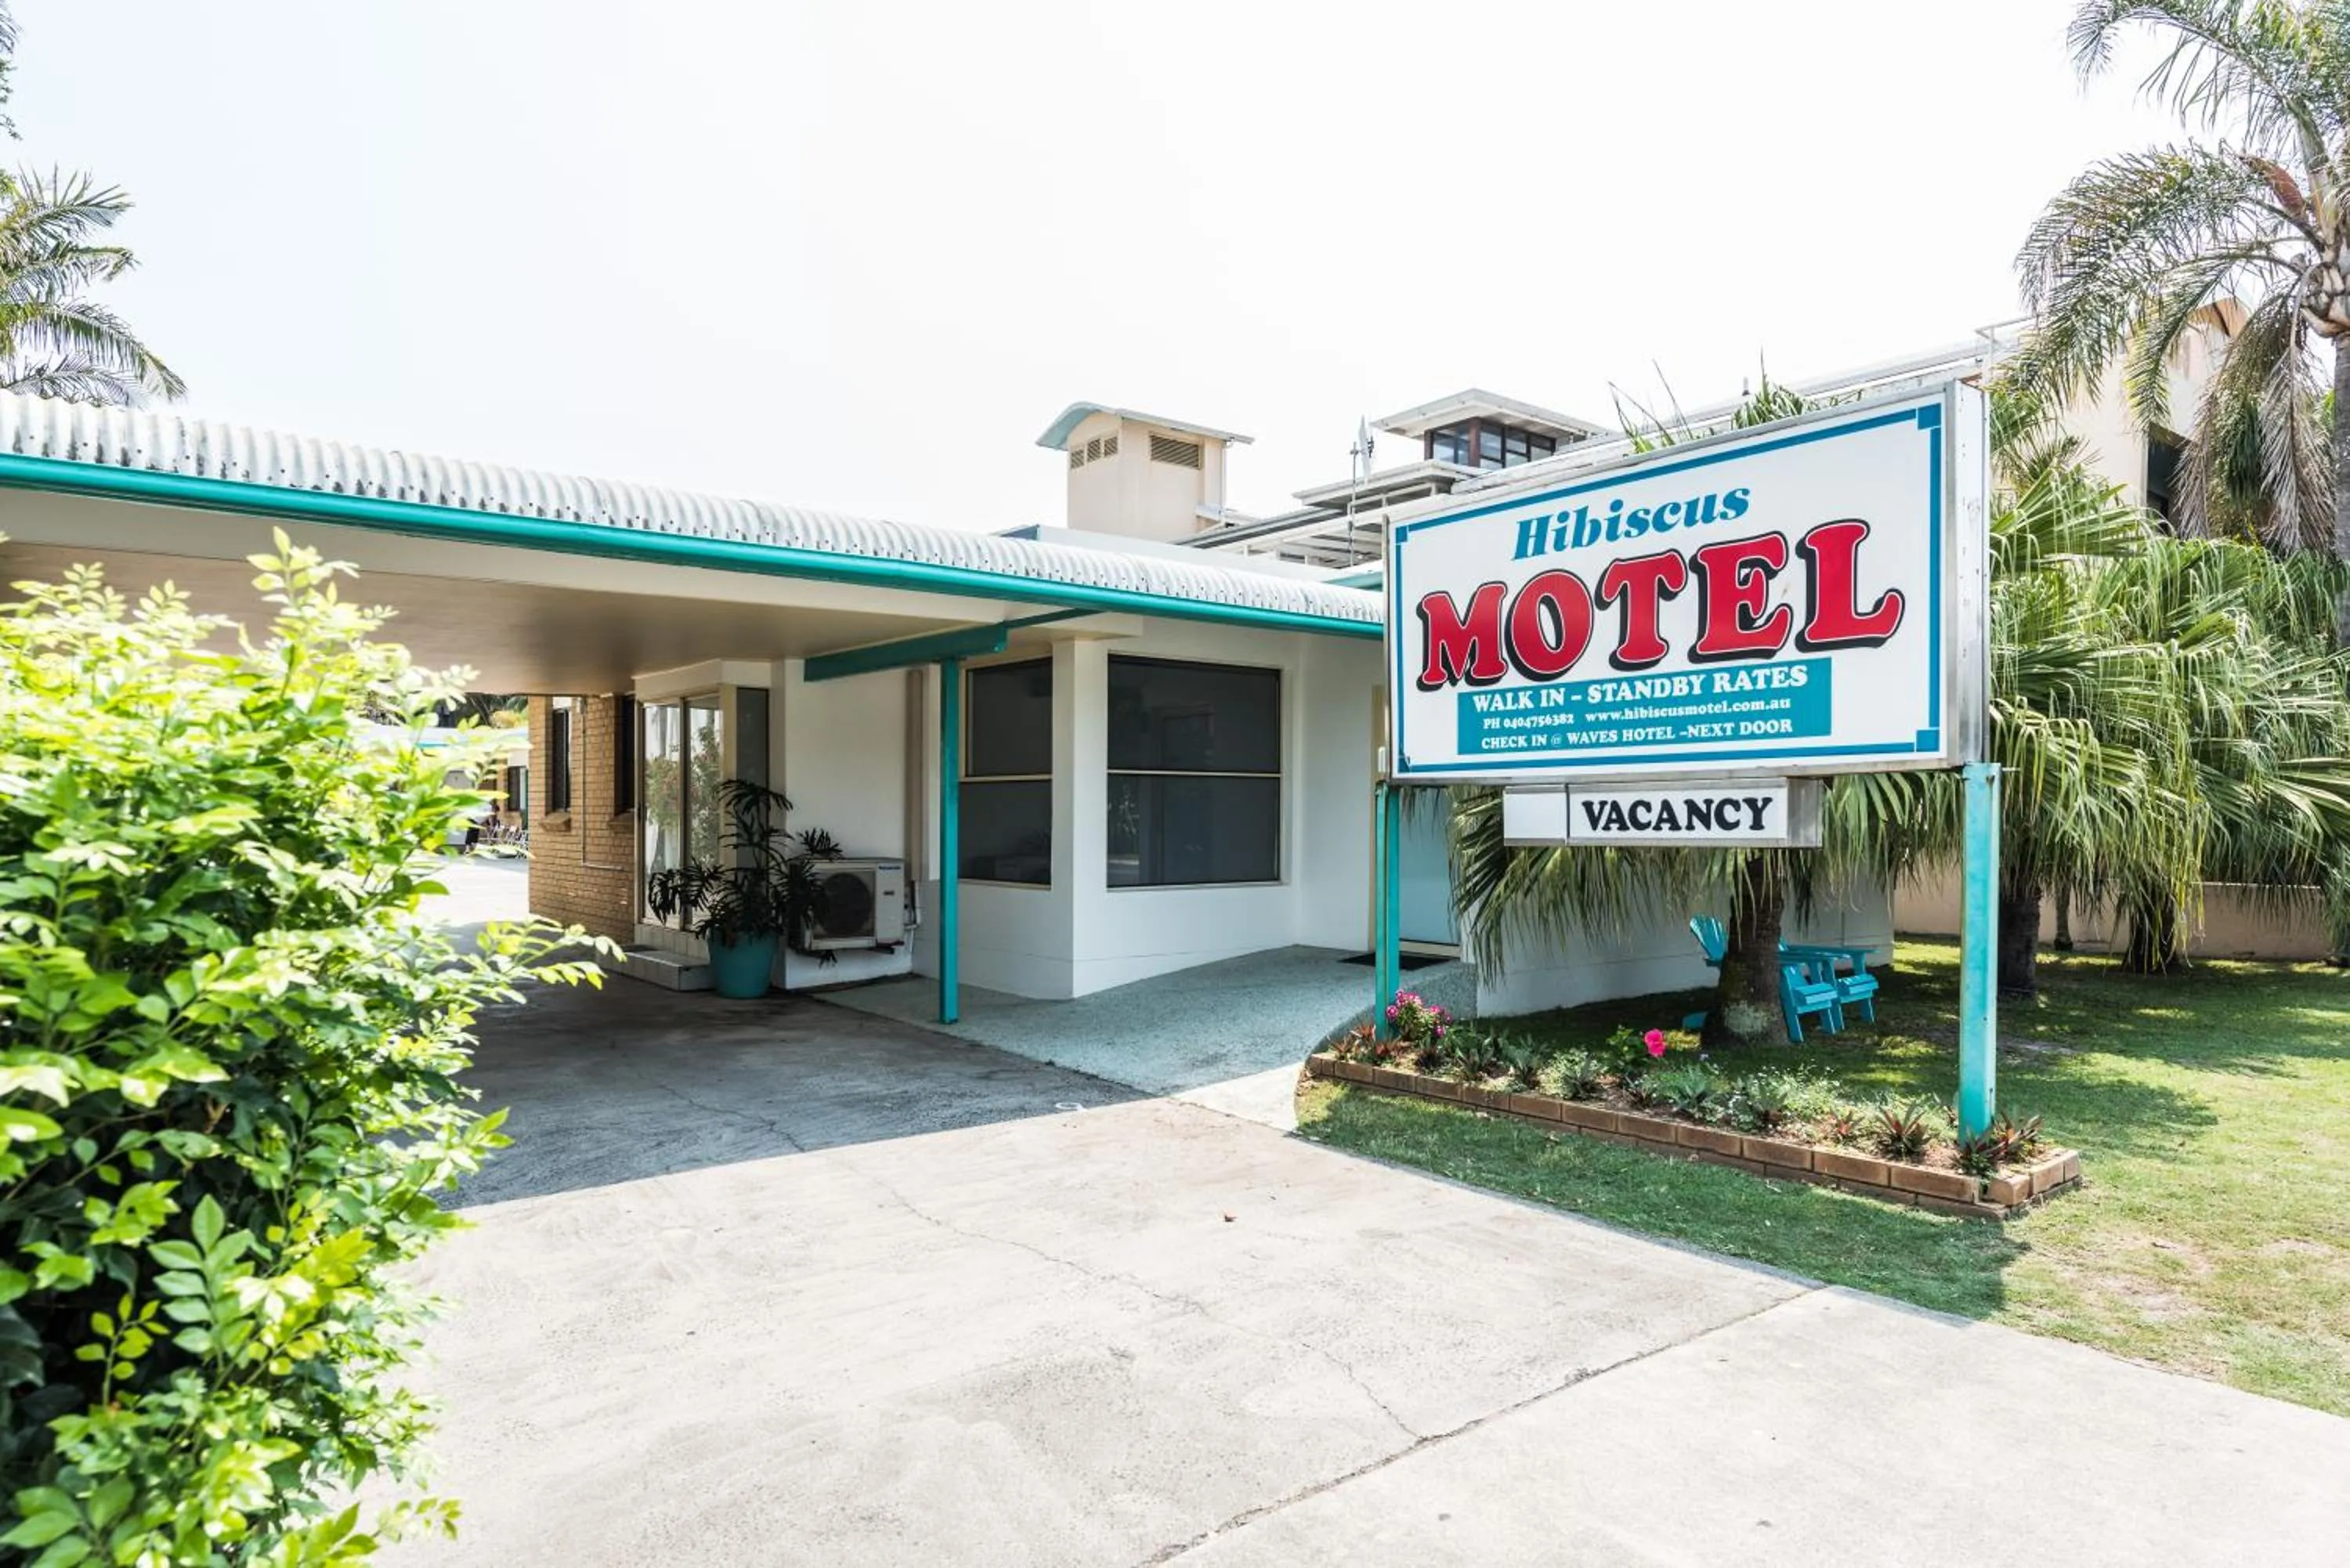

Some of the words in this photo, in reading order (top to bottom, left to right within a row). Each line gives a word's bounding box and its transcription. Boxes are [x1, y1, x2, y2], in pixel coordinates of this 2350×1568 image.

[1511, 487, 1752, 560] Hibiscus
[1416, 518, 1905, 692] MOTEL
[1473, 690, 1534, 712] WALK
[1540, 688, 1565, 707] IN
[1587, 674, 1706, 703] STANDBY
[1713, 665, 1809, 693] RATES
[1483, 717, 1500, 729] PH
[1585, 698, 1791, 721] www.hibiscusmotel.com.au
[1481, 735, 1528, 750] CHECK
[1531, 734, 1547, 746] IN
[1550, 732, 1563, 746] @
[1567, 730, 1618, 745] WAVES
[1622, 726, 1676, 742] HOTEL
[1739, 719, 1792, 735] DOOR
[1582, 797, 1773, 832] VACANCY
